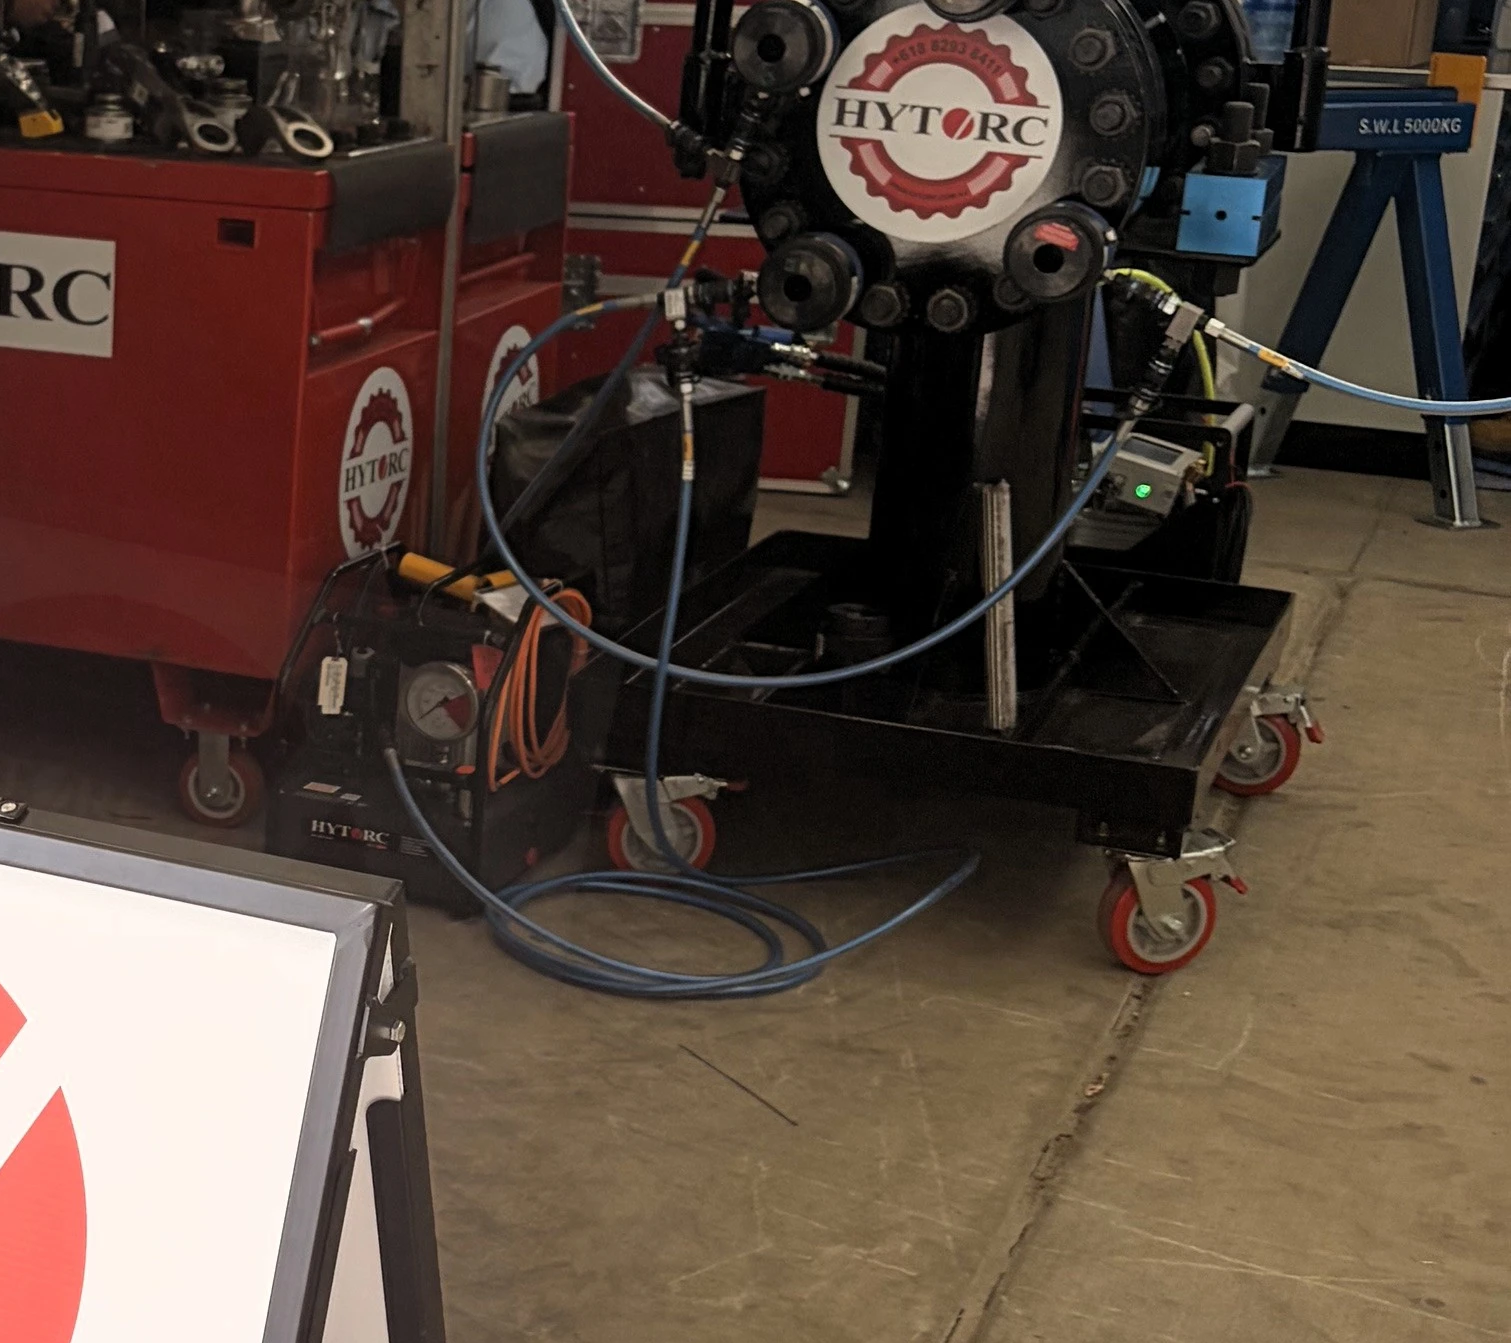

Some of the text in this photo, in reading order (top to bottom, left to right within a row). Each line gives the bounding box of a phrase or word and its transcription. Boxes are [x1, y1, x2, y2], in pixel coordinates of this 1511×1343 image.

[833, 96, 1049, 147] HYTORC
[344, 448, 410, 493] HYTORC
[310, 819, 390, 844] HYTORC
